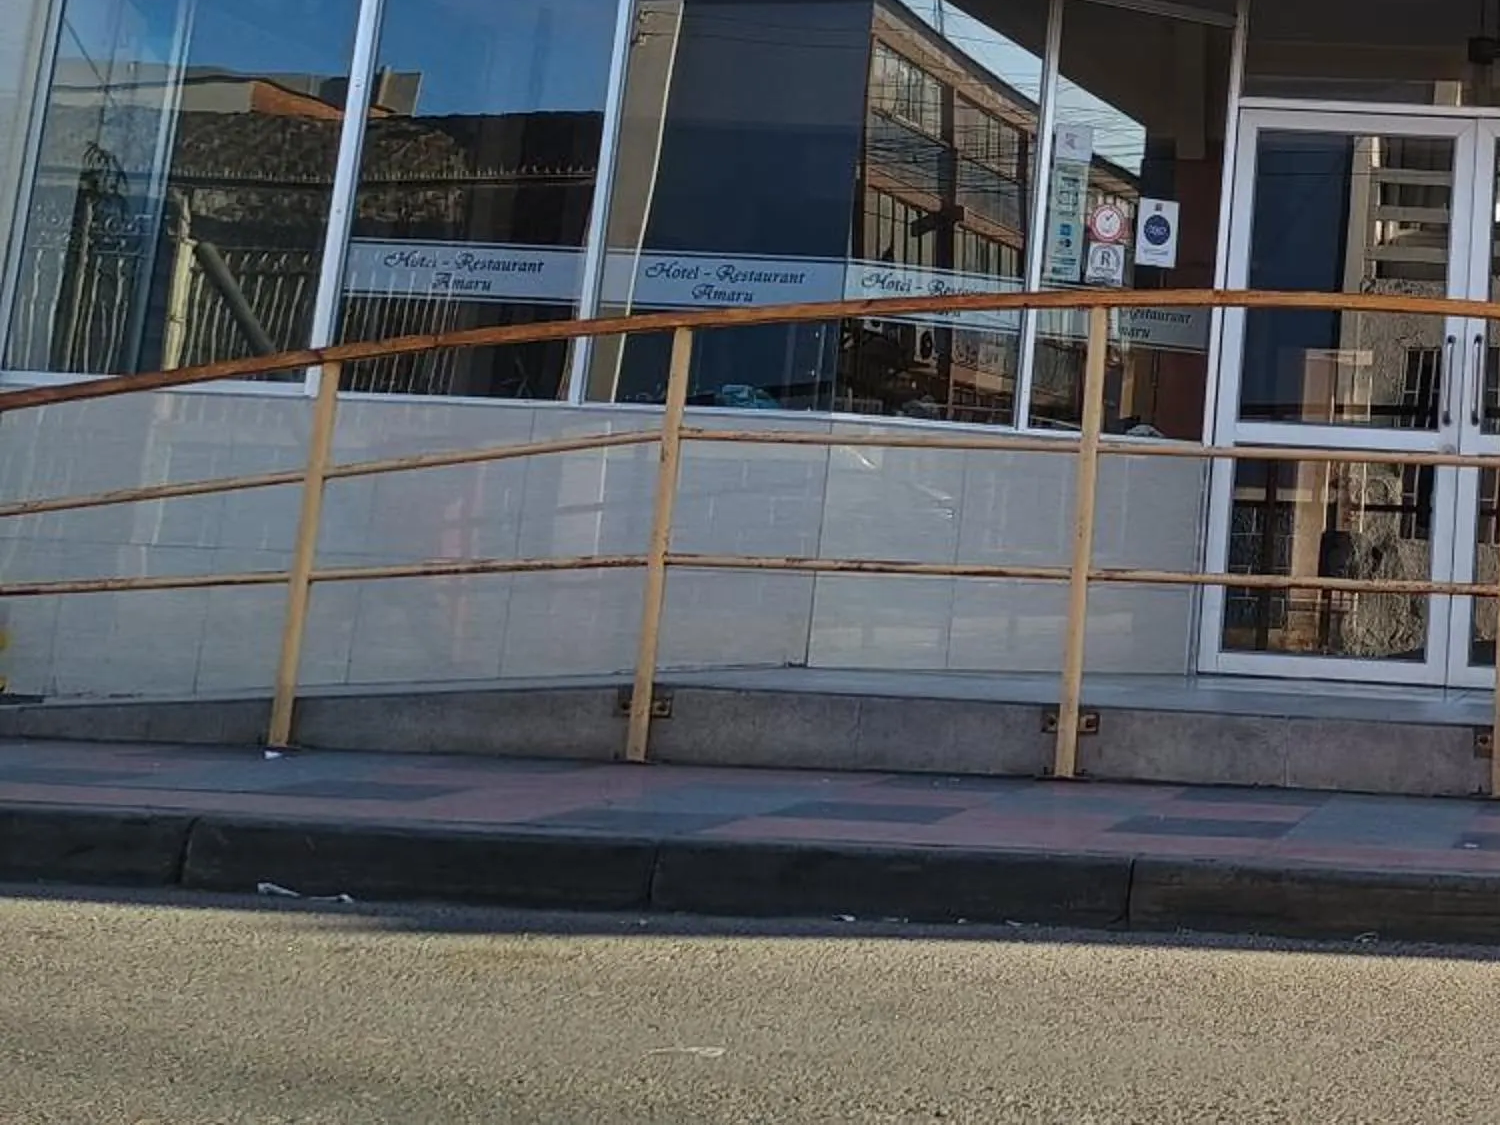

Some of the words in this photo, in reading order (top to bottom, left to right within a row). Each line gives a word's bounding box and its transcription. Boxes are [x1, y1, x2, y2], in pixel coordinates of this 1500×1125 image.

[384, 250, 437, 268] Hotel
[454, 252, 545, 273] Restaurant
[645, 260, 700, 280] Hotel
[716, 264, 806, 284] Restaurant
[432, 272, 493, 291] Amaru
[691, 282, 754, 302] Amaru
